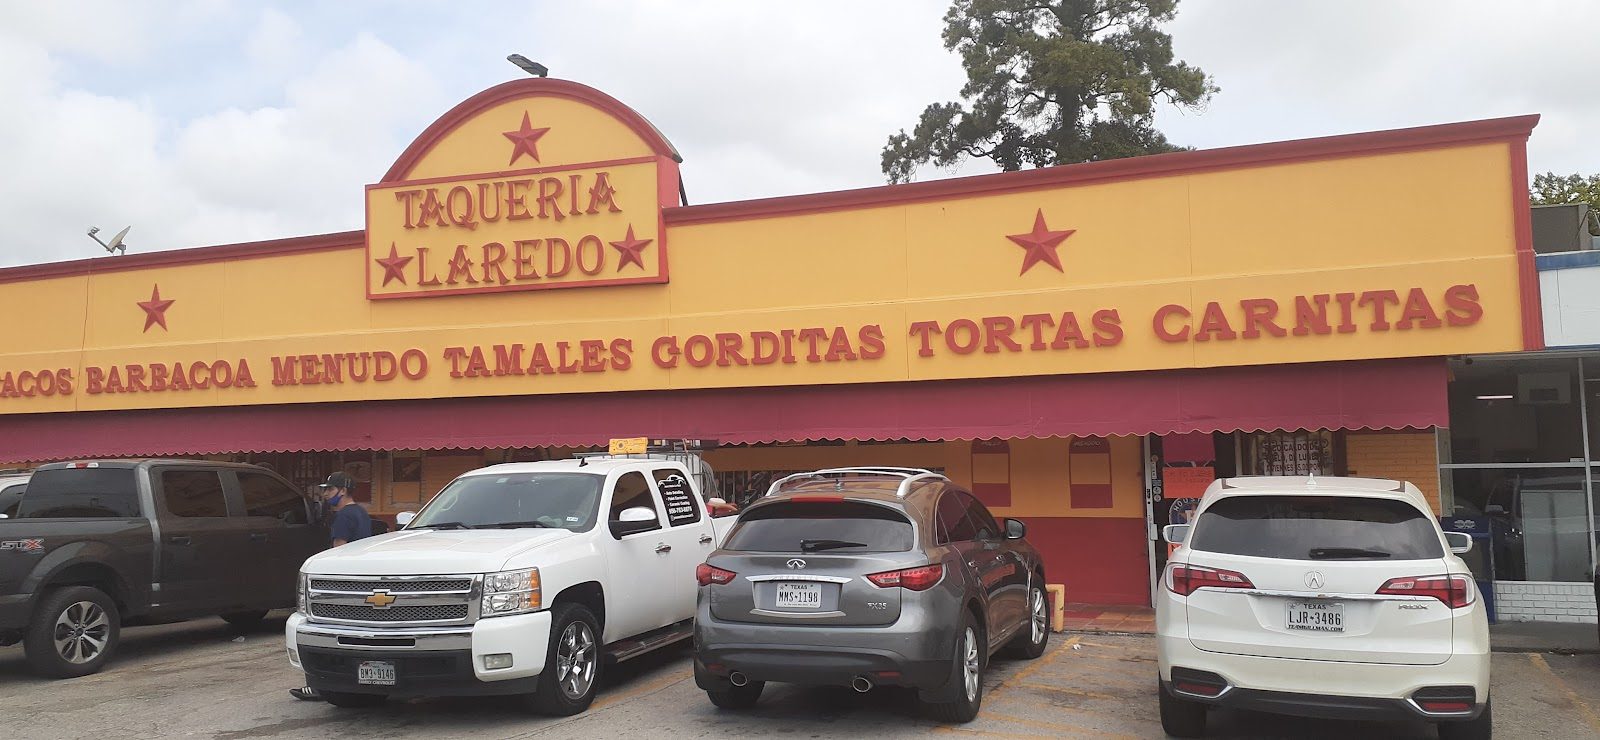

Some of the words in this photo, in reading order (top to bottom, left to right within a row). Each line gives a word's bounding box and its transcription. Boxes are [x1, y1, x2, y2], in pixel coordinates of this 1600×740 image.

[394, 172, 622, 231] TAQUERIA
[416, 234, 606, 286] LAREDO
[0, 368, 74, 397] ACOS
[86, 358, 257, 395] BARBACOA
[270, 348, 428, 387] MENUDO
[443, 338, 633, 378] TAMALES
[651, 324, 886, 368] GORDITAS
[909, 308, 1124, 357] TORTAS
[1152, 284, 1483, 343] CARNITAS
